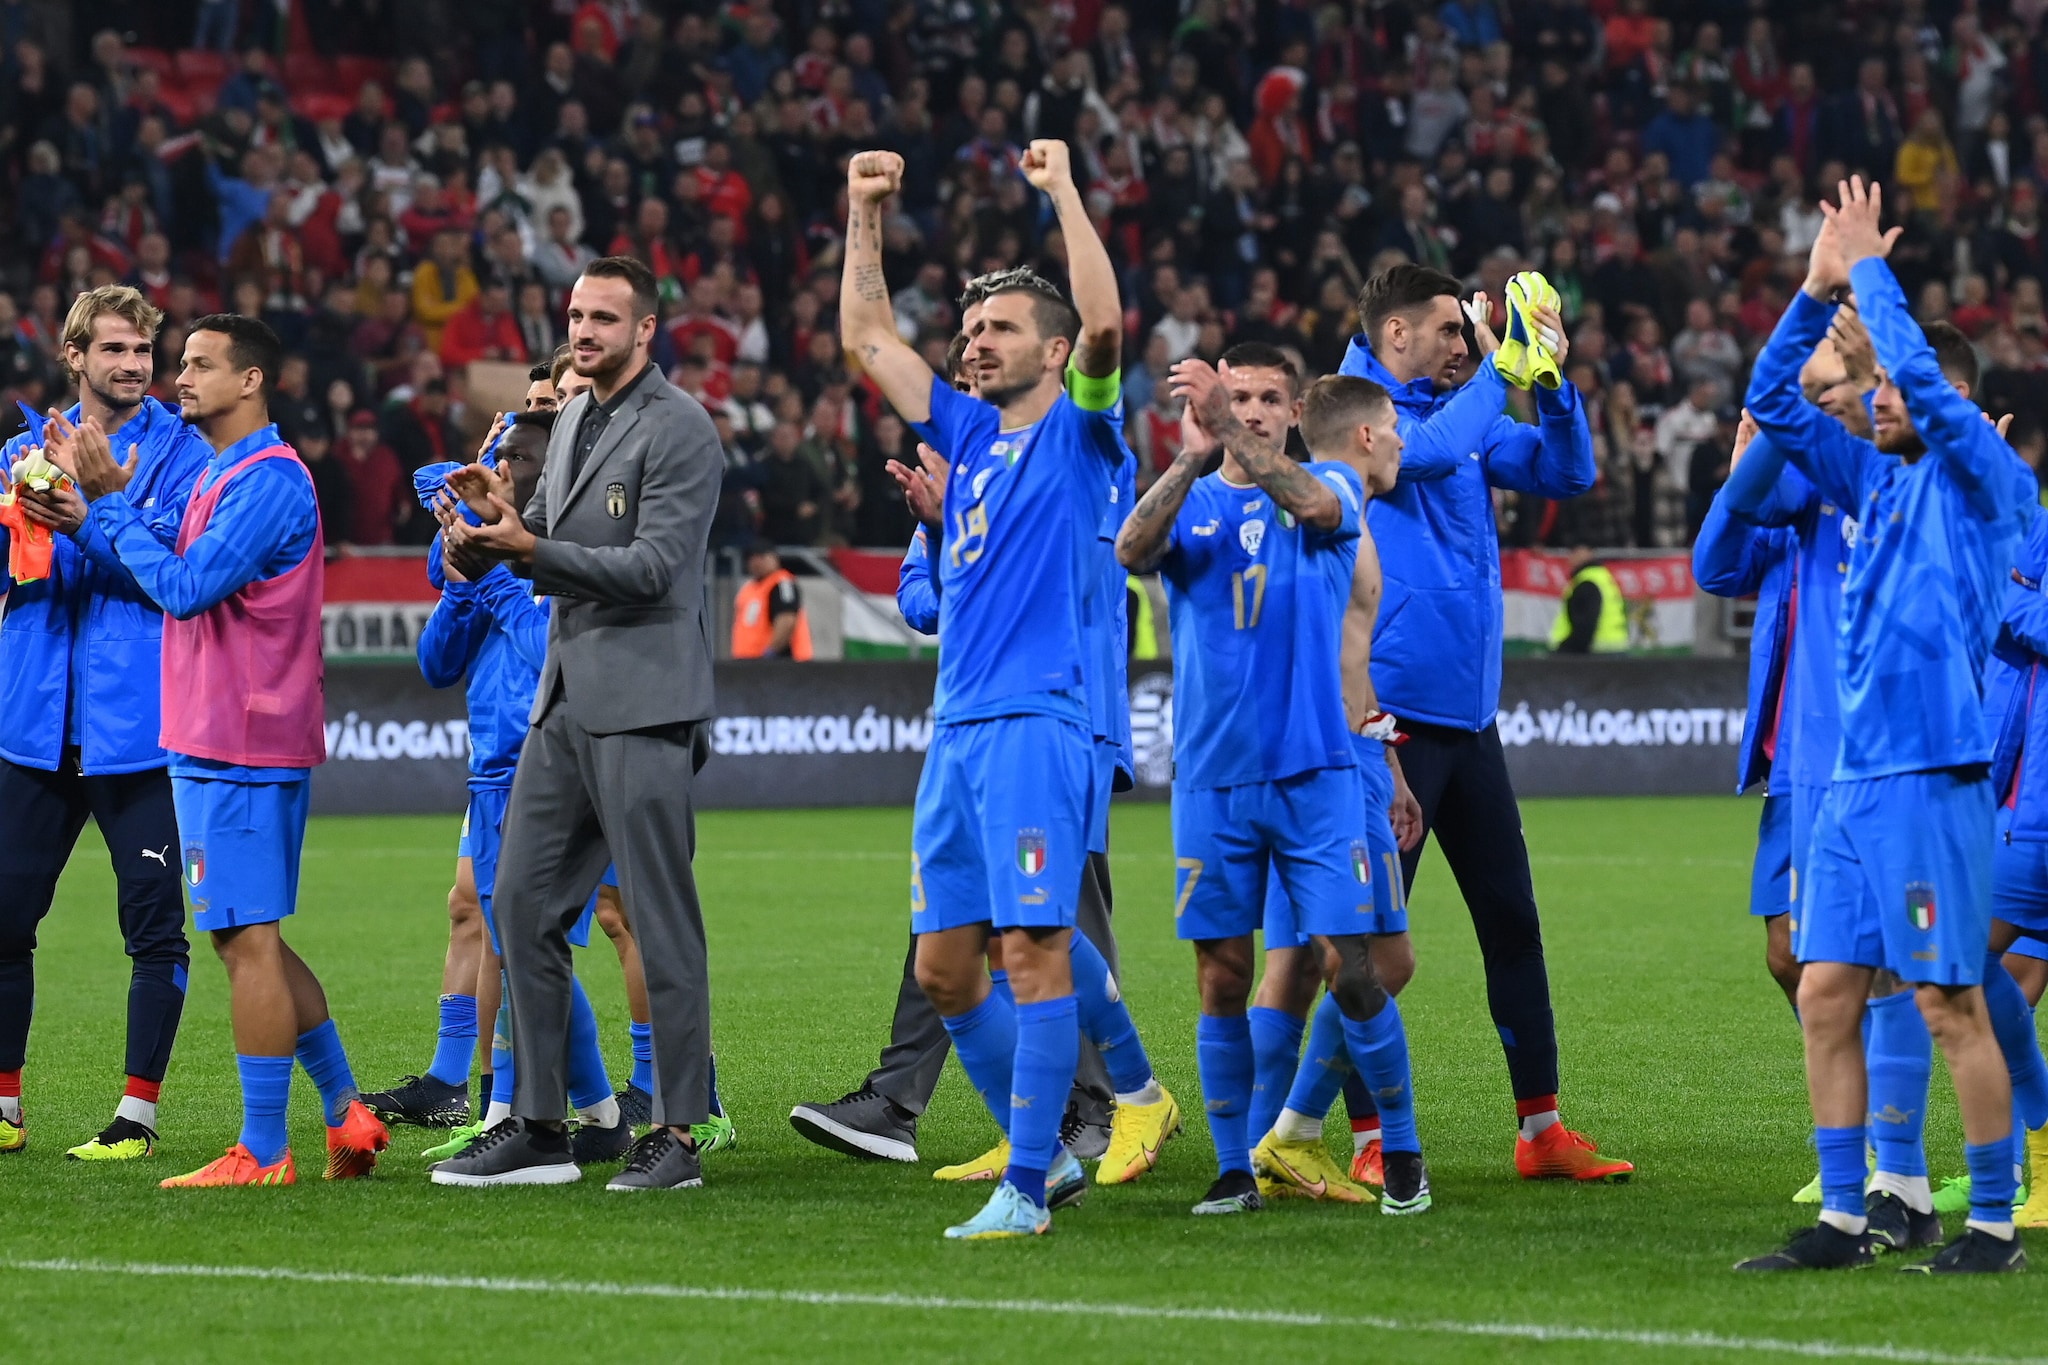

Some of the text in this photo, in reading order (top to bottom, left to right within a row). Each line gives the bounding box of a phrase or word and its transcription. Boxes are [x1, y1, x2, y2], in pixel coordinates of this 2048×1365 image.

[951, 501, 989, 568] 19
[1232, 563, 1267, 630] 17
[325, 711, 472, 760] VÁLOGAT
[713, 705, 890, 755] SZURKOLÓI
[1174, 857, 1203, 918] 7
